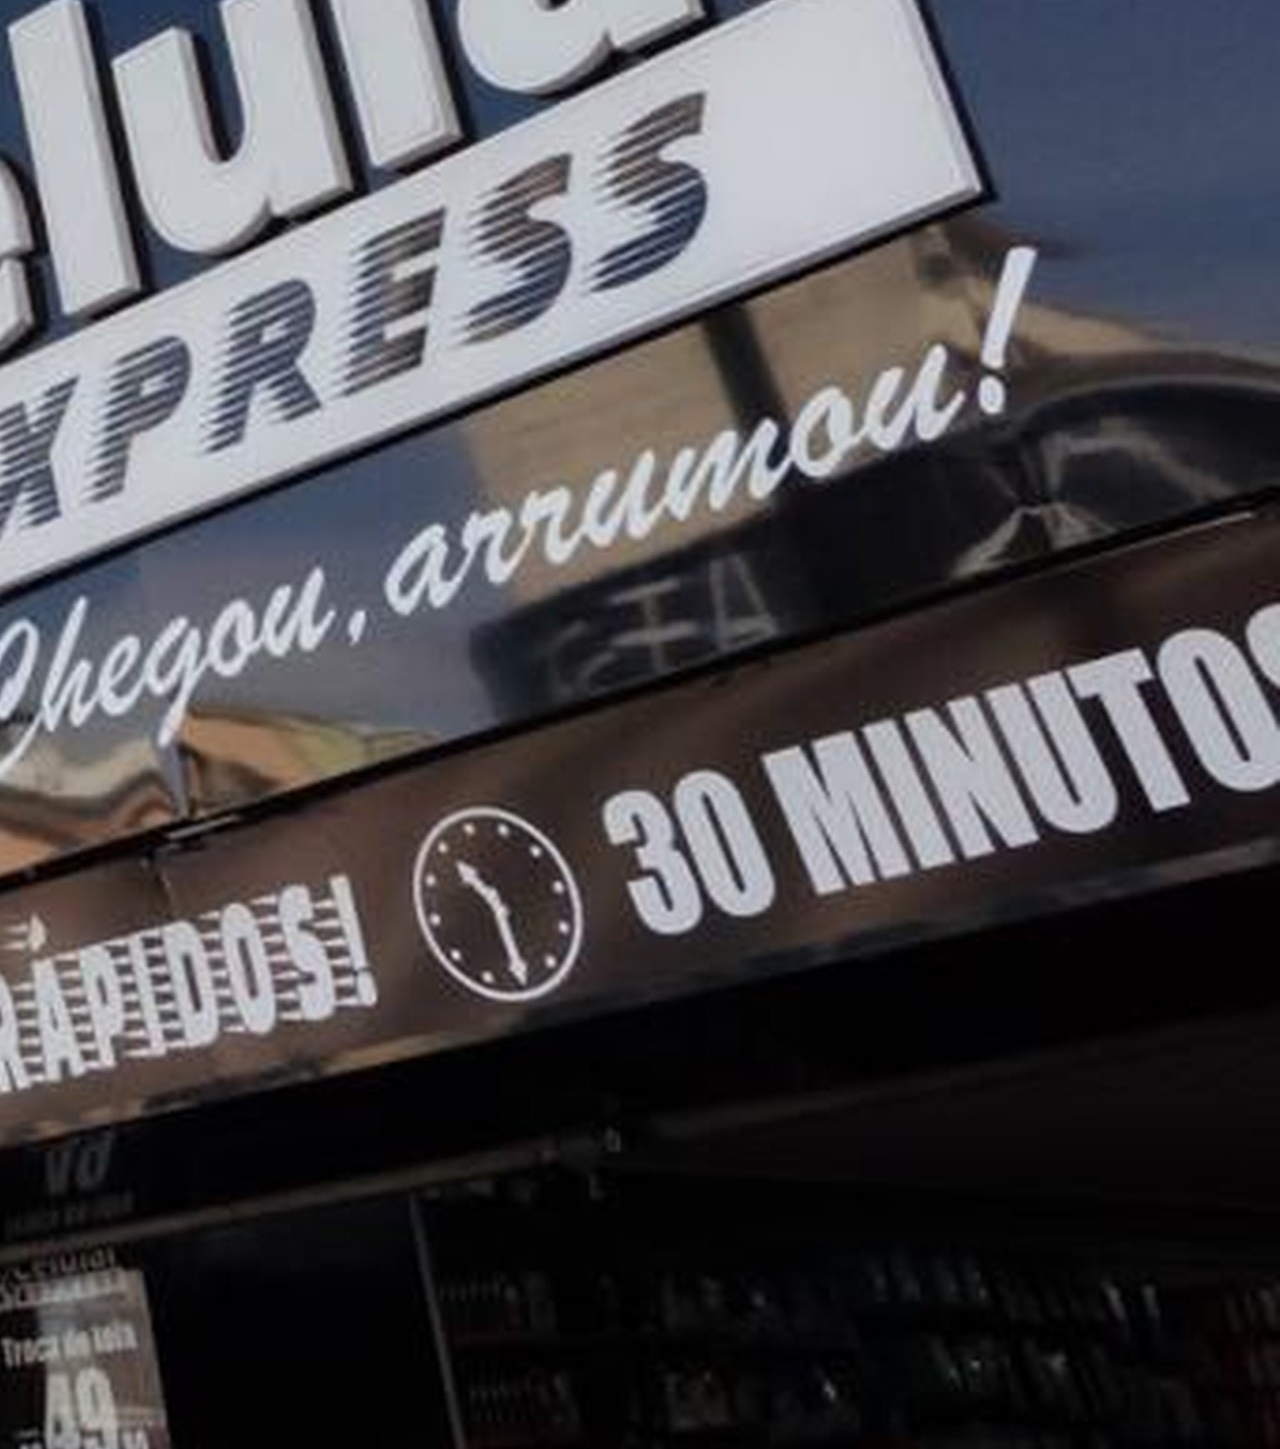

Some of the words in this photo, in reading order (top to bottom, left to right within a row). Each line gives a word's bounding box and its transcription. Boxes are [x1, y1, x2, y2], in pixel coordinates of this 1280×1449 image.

[385, 247, 1038, 616] arrumou!
[600, 771, 770, 936] 30
[762, 601, 1280, 896] MINUTO
